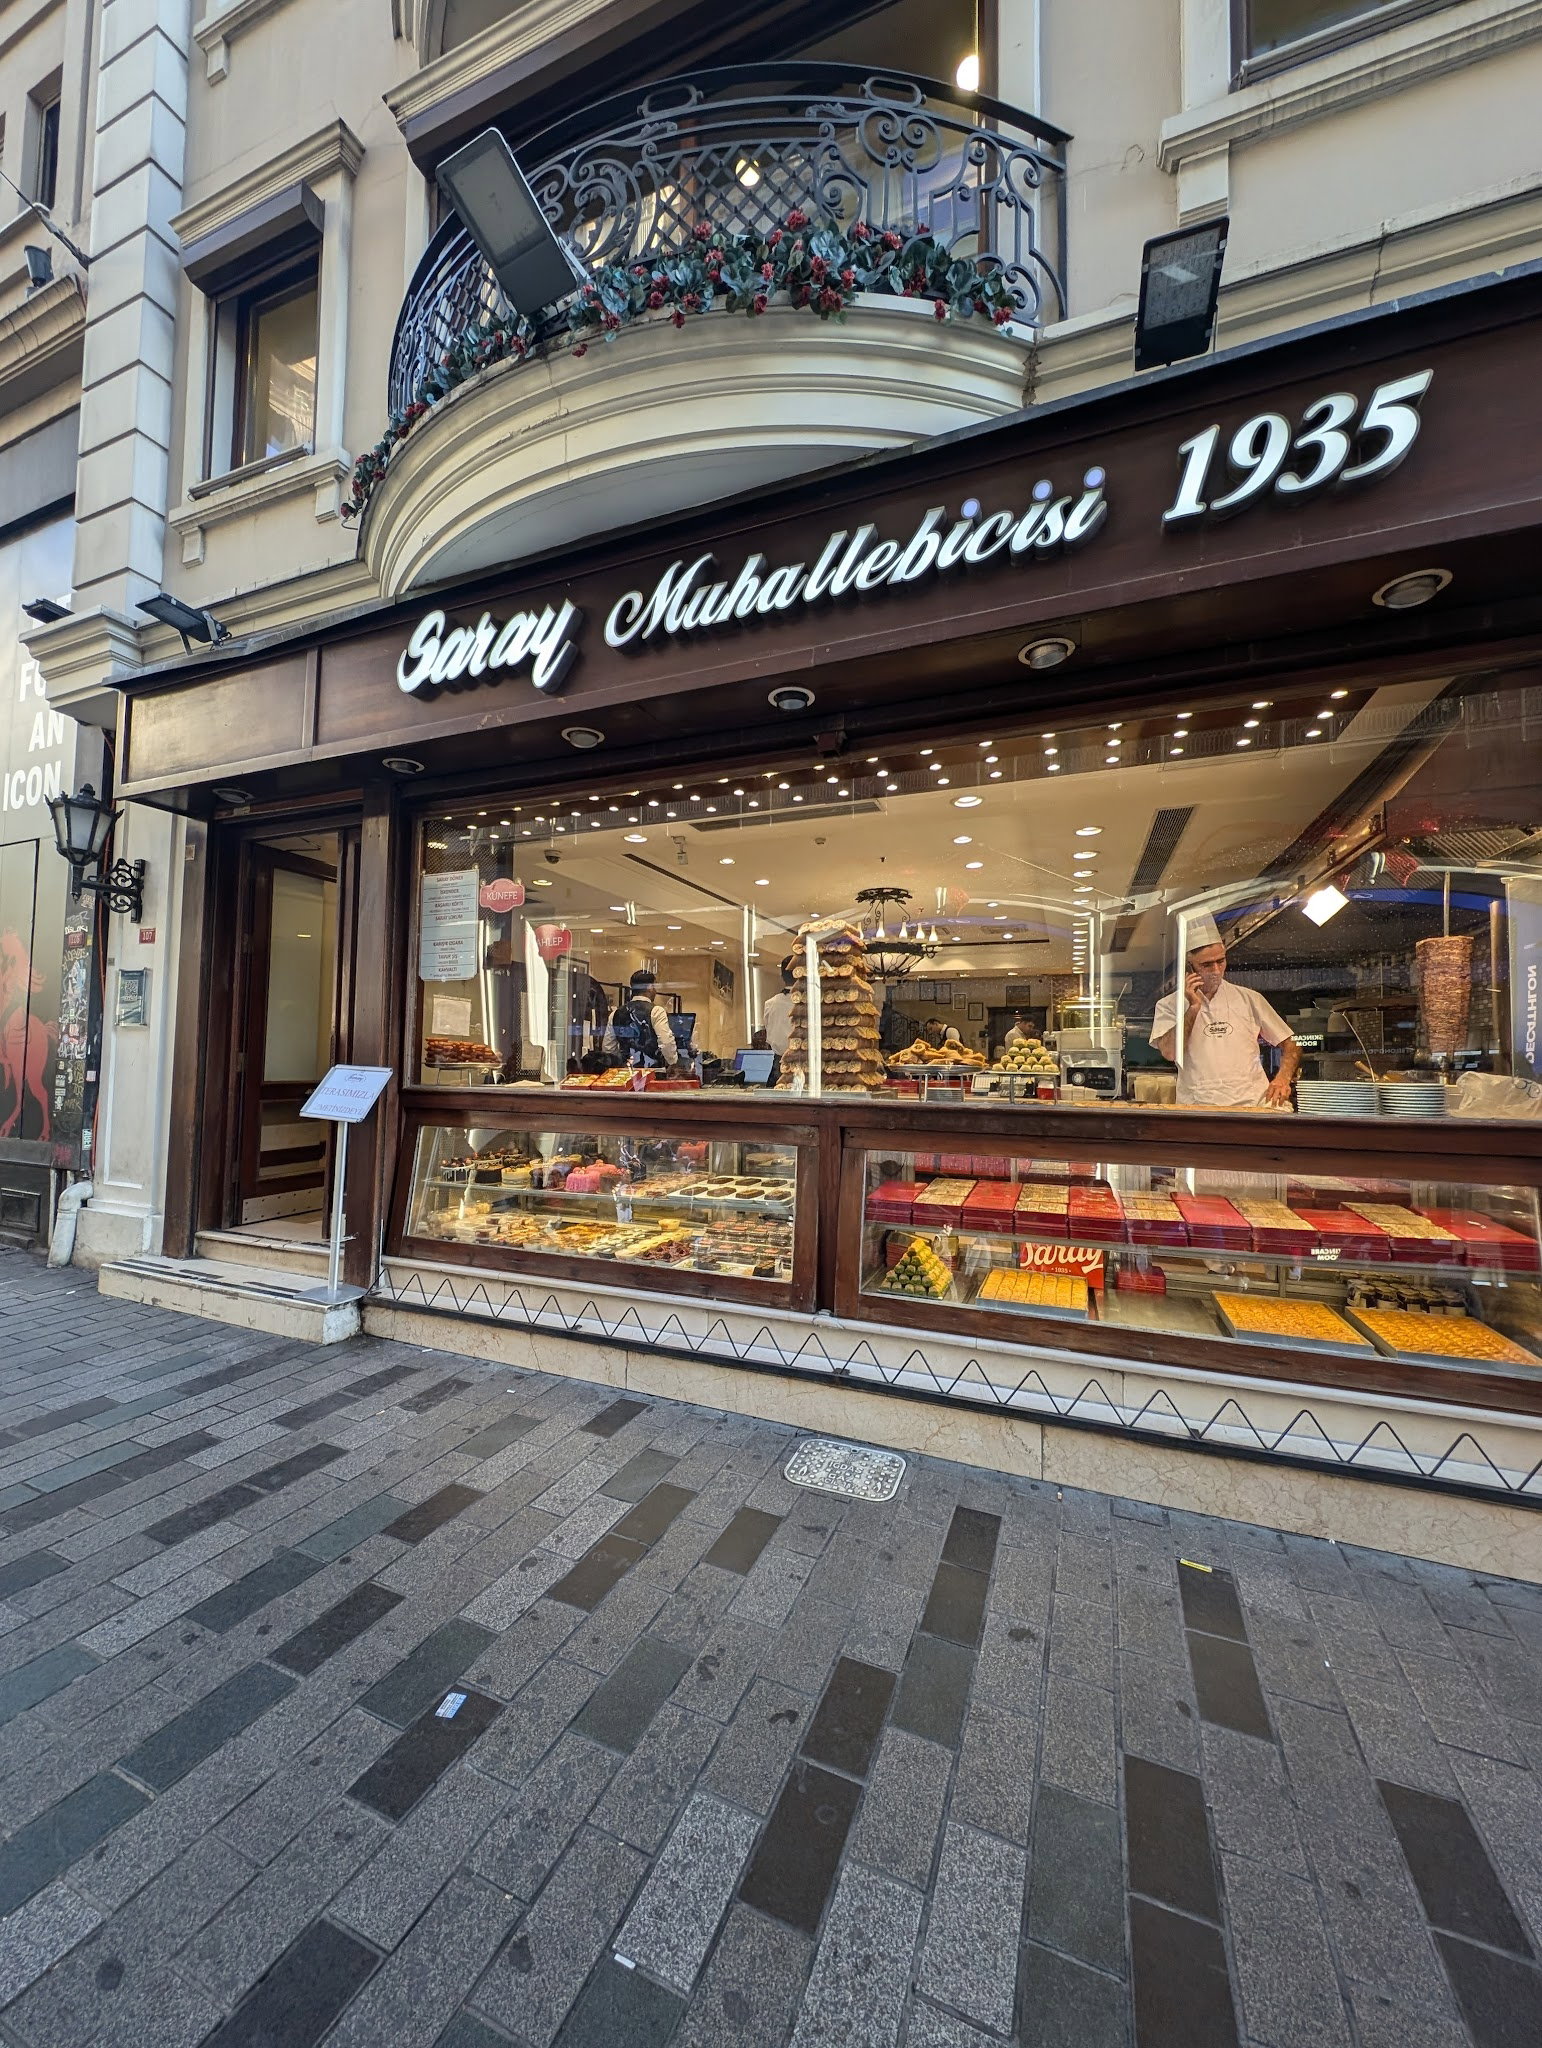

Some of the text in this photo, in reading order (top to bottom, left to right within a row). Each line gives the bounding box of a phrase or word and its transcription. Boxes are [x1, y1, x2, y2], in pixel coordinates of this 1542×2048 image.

[397, 368, 1434, 694] Saray Muhallebicisi 1935
[28, 710, 65, 753] AN
[3, 760, 62, 812] ICON
